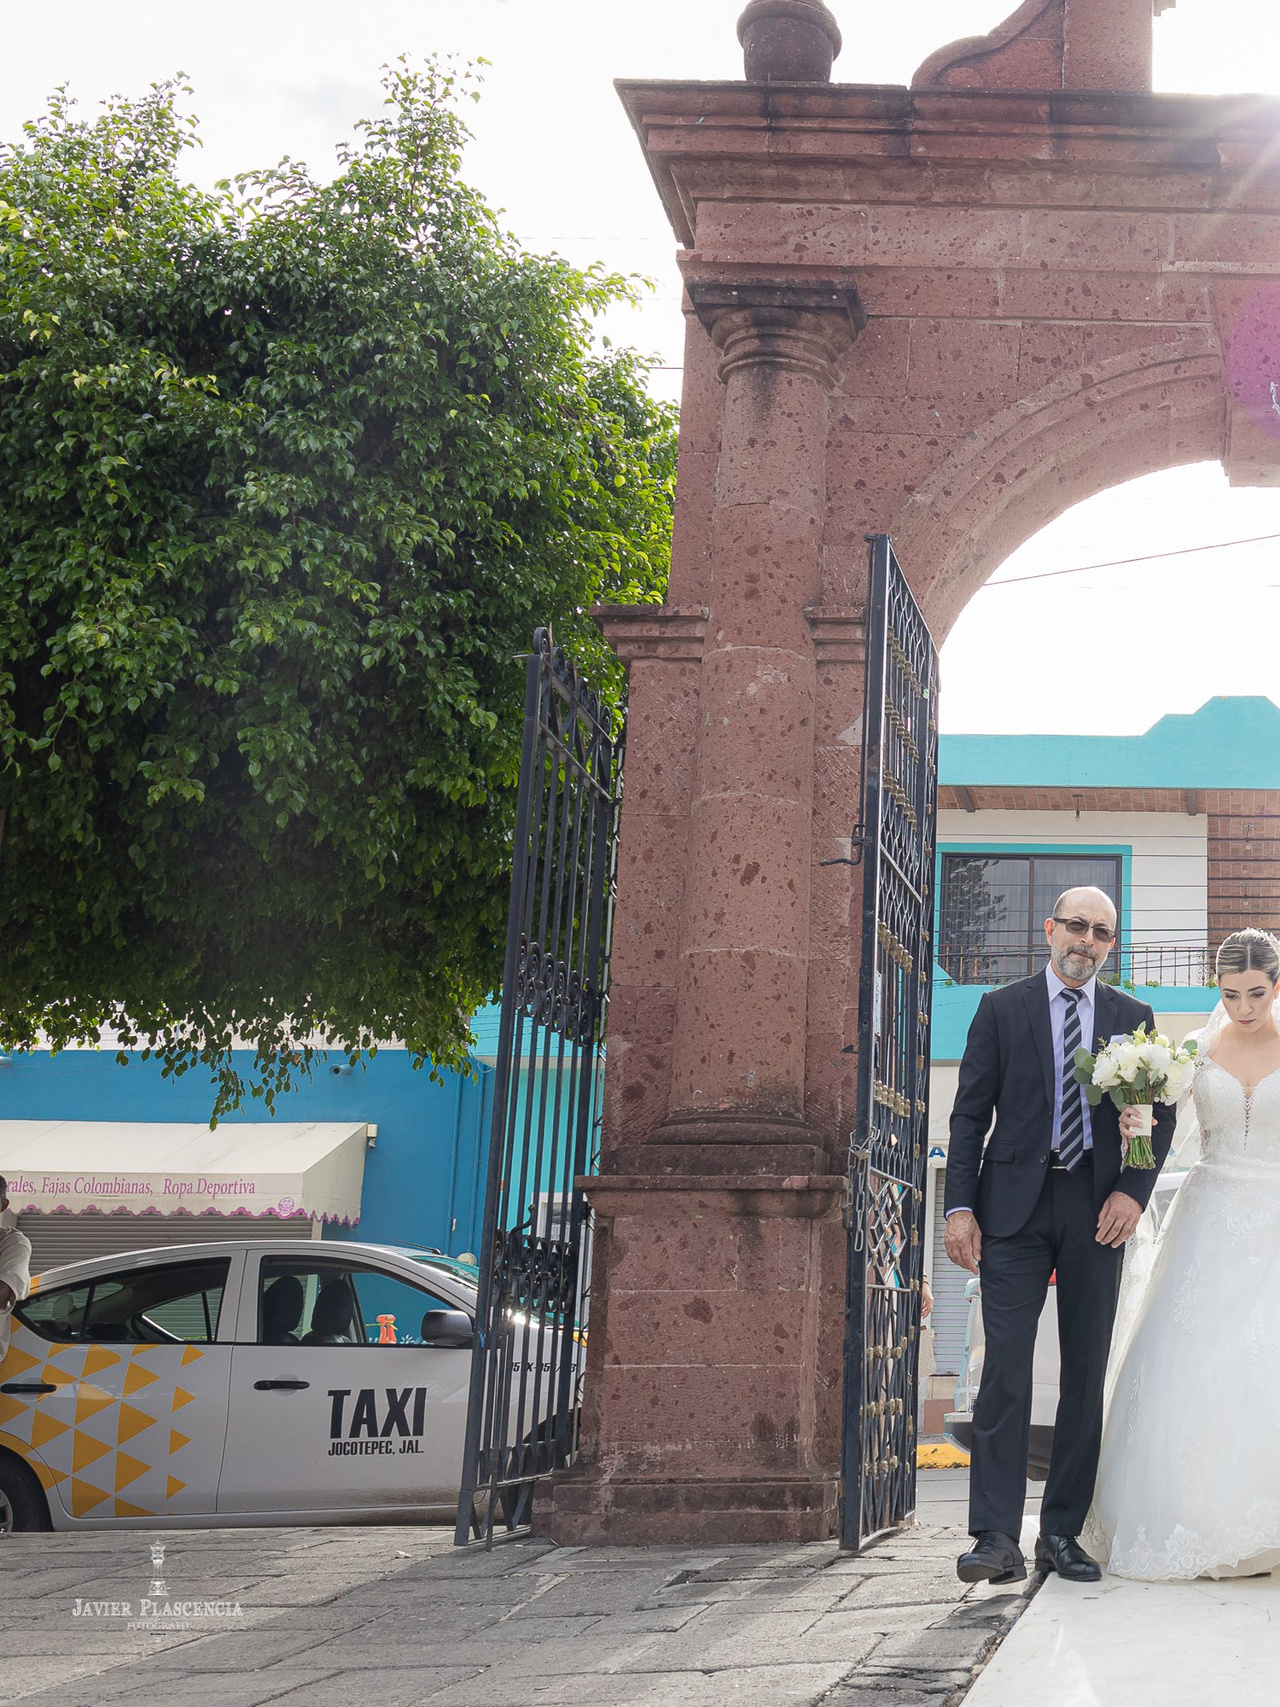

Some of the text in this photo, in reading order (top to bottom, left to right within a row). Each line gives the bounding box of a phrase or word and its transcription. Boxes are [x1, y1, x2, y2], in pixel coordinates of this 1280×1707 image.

[6, 1175, 256, 1199] rales, Fajas Colombianas, Ropa Deportiva
[327, 1387, 427, 1439] TAXI
[328, 1439, 424, 1456] JOCOTEPEC, JAL.
